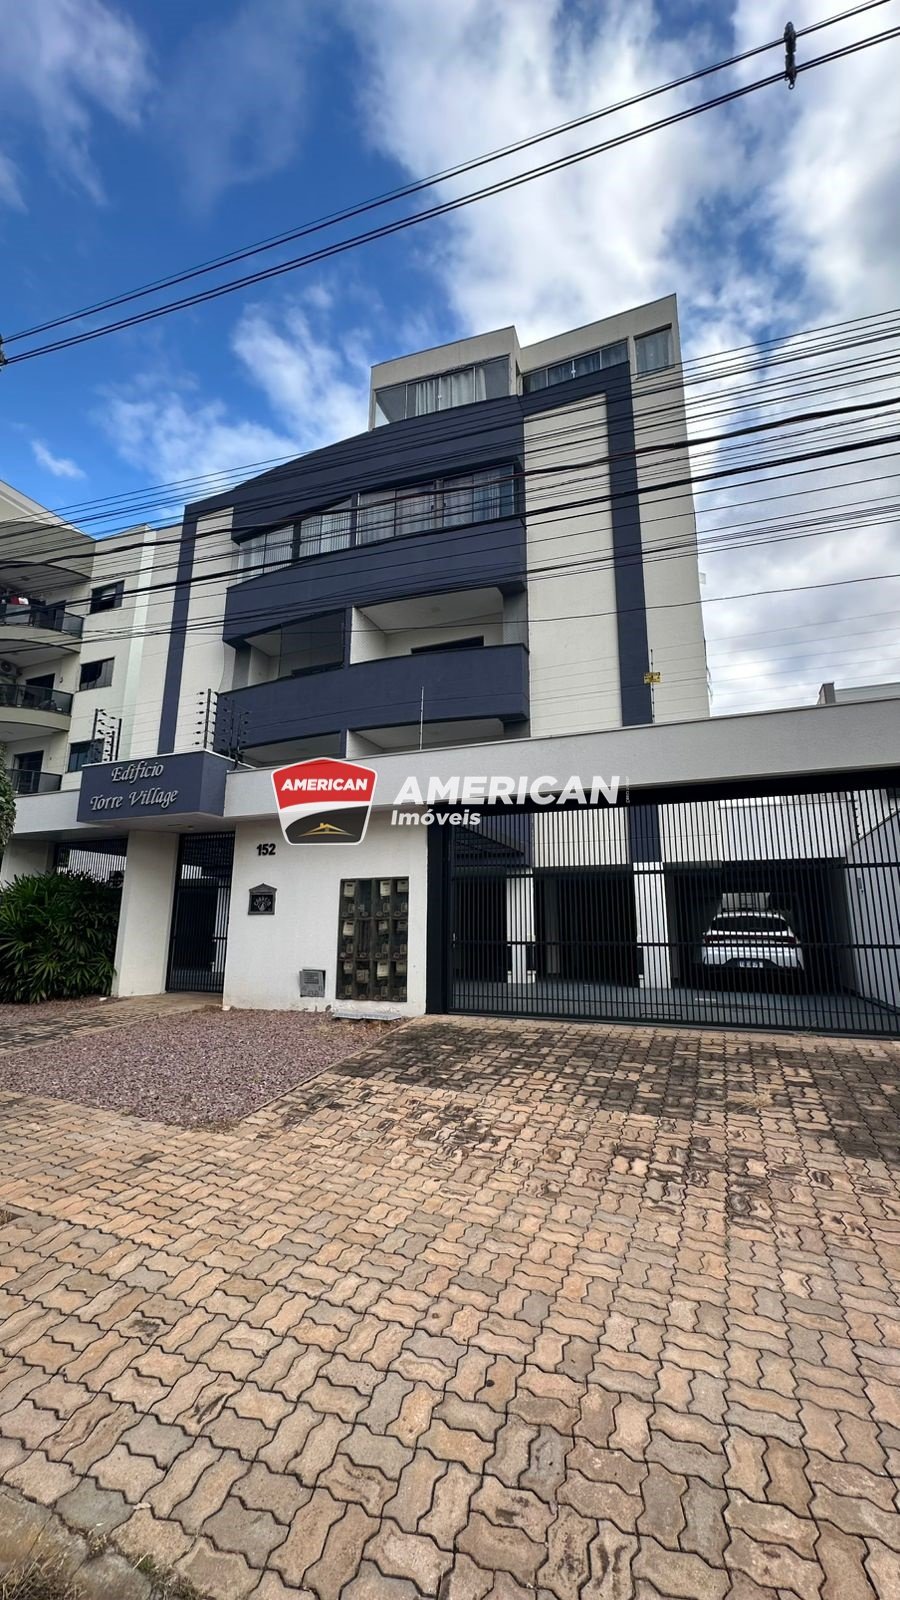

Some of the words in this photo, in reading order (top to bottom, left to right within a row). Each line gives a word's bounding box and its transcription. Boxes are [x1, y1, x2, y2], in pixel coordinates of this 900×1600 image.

[90, 795, 124, 811] Torre
[128, 787, 179, 809] Village
[256, 843, 276, 856] 152
